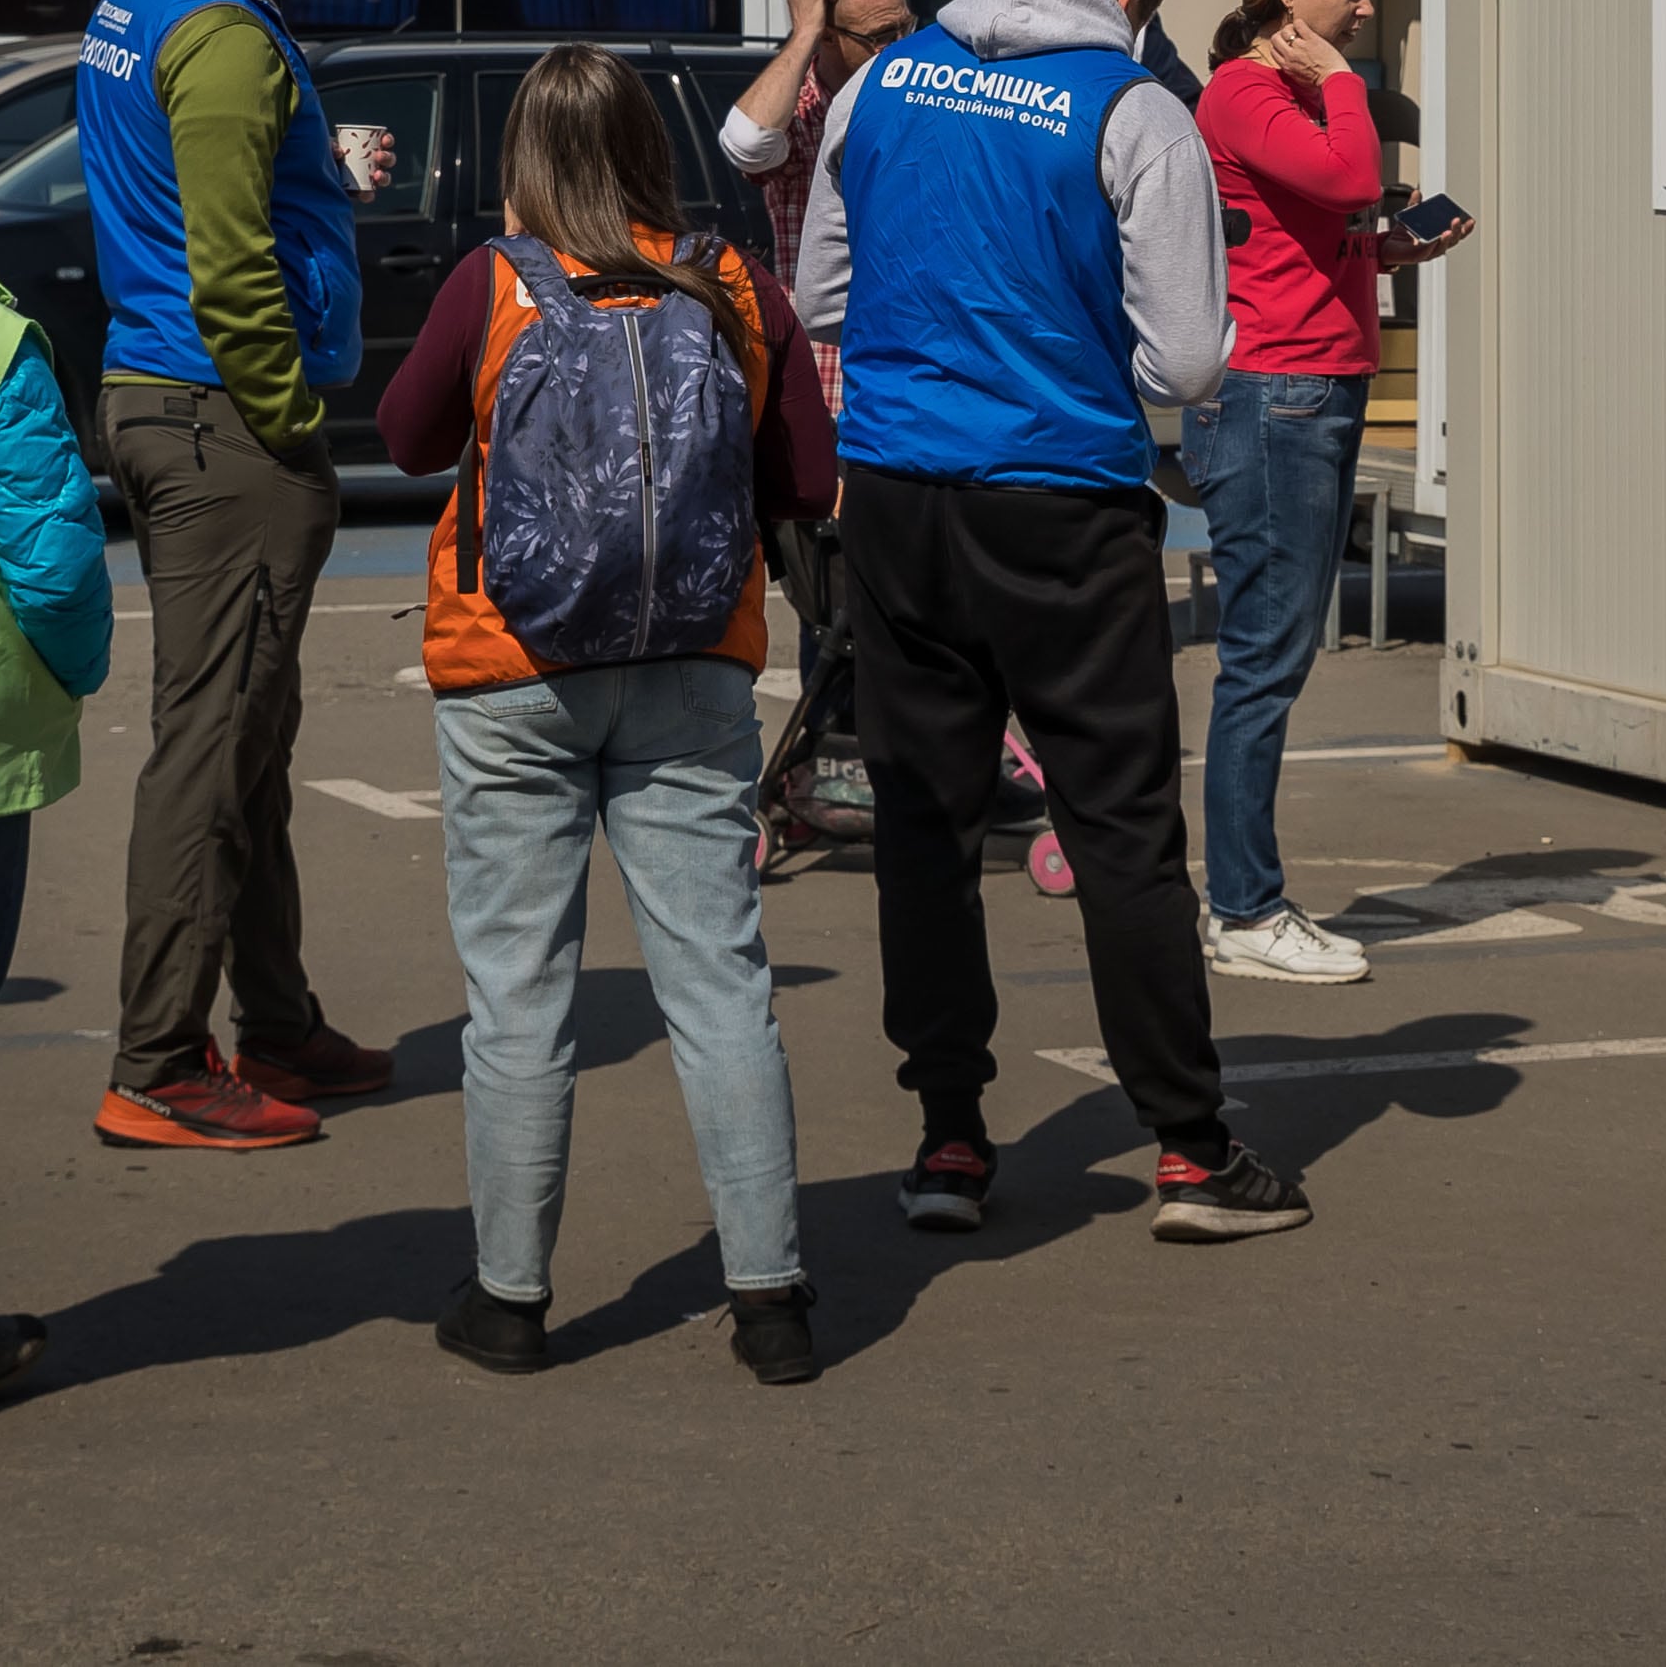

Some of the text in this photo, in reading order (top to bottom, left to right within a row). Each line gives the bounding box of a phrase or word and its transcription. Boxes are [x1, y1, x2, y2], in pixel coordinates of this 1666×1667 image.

[910, 62, 1072, 118] ПОСМІШКА
[905, 91, 1068, 138] БЛАГОДІЙНИЙ ФОНД
[816, 757, 869, 783] El Ca
